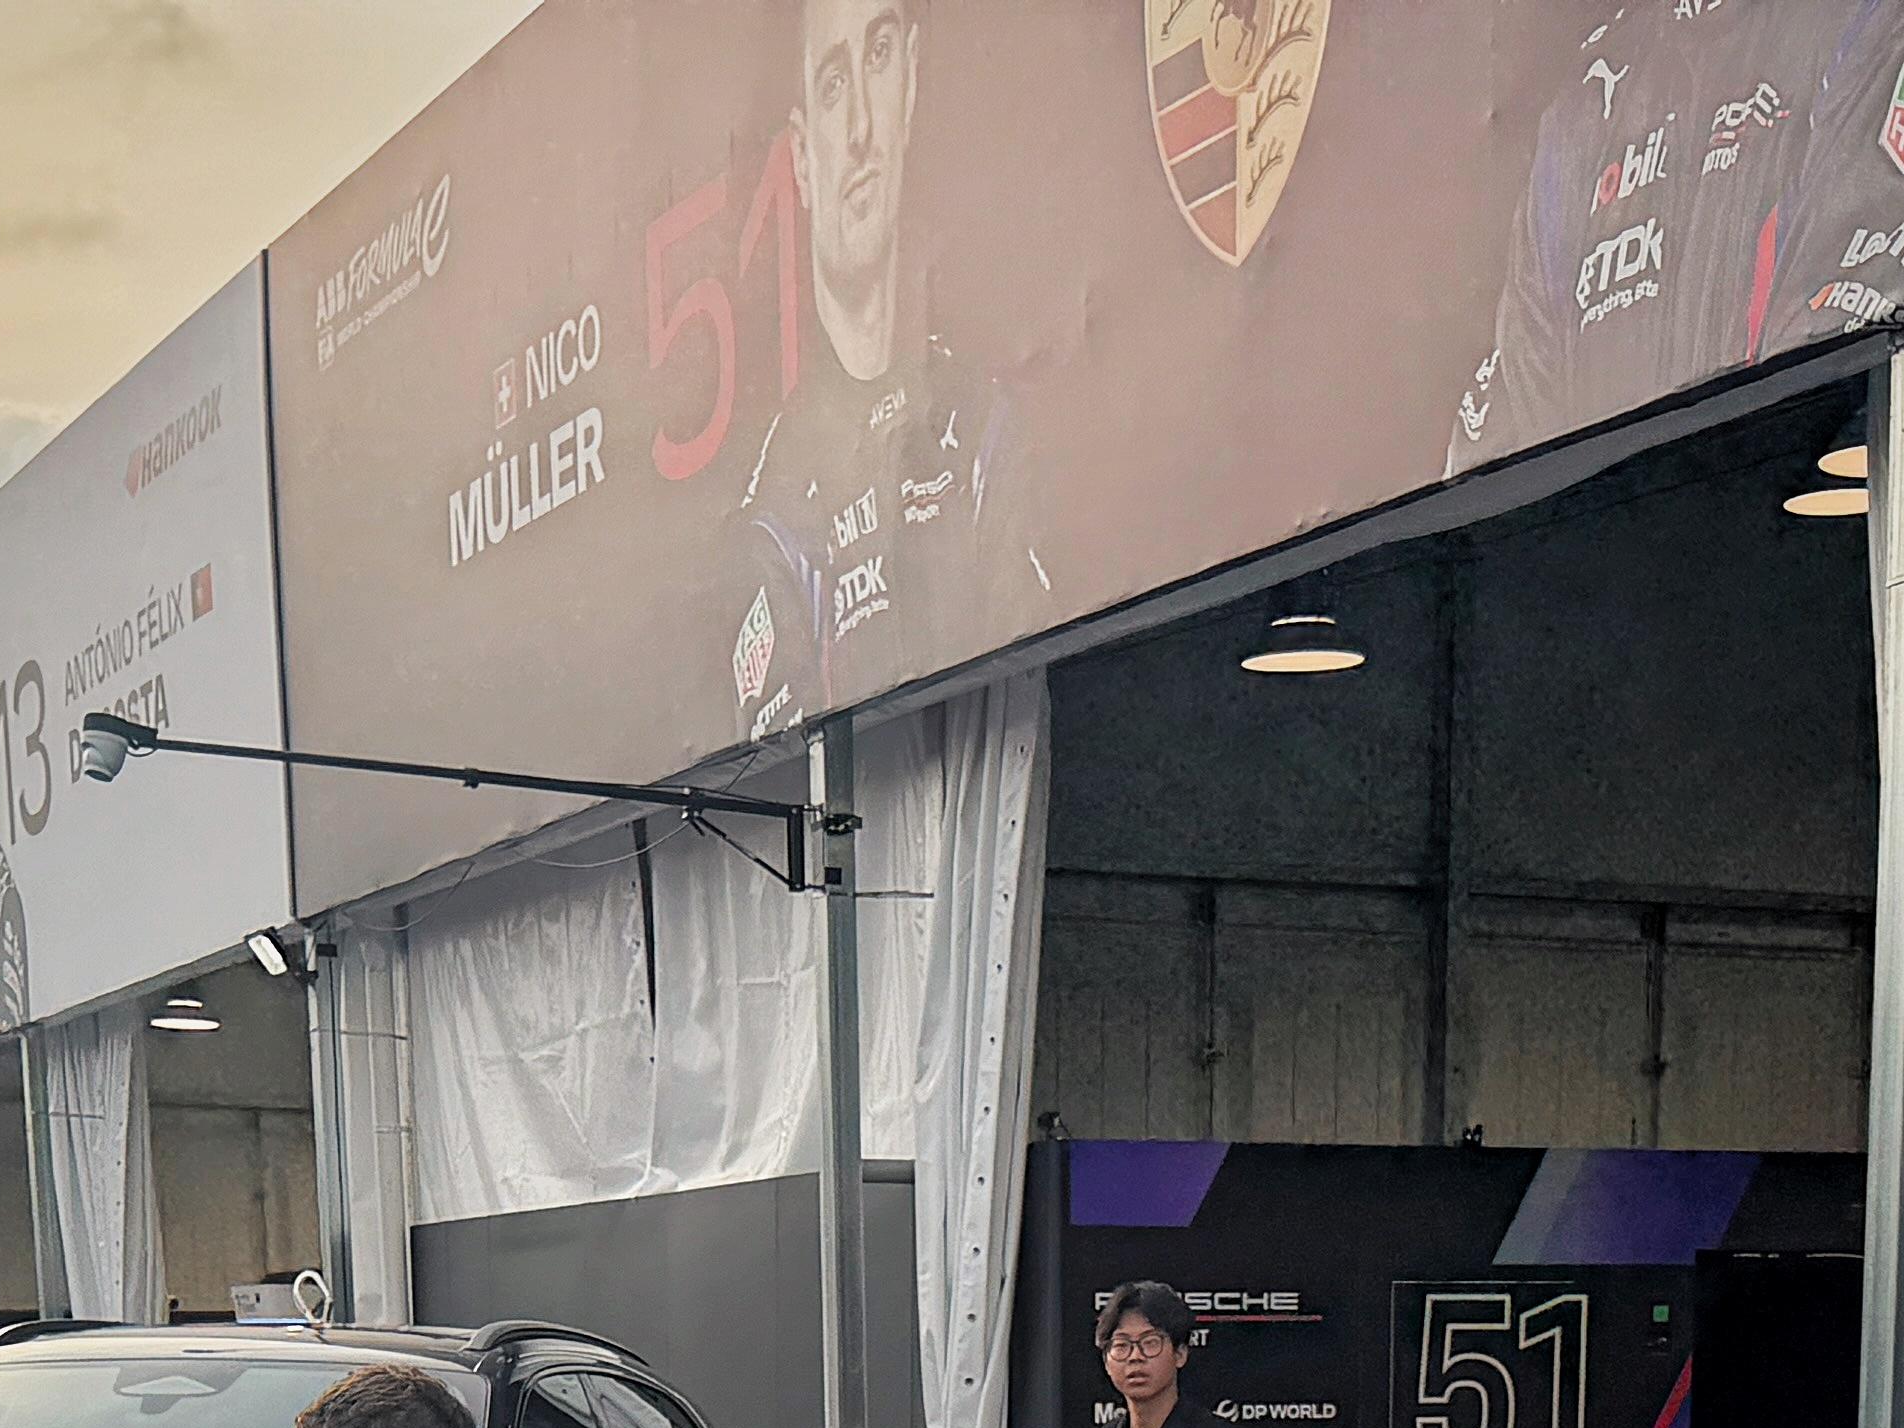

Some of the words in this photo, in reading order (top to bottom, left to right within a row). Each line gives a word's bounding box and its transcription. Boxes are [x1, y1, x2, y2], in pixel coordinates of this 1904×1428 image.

[1590, 127, 1666, 217] obil
[346, 198, 425, 312] FORMULA
[1594, 217, 1663, 292] TDK
[644, 125, 802, 483] 51
[525, 304, 602, 409] NICO
[447, 406, 607, 567] MÜLLER
[65, 622, 134, 706] ANTÓNIO
[136, 584, 186, 658] FÉLIX
[67, 727, 84, 784] D
[1095, 1292, 1301, 1311] PSCHE
[1241, 1405, 1269, 1420] DP
[1269, 1404, 1337, 1420] WORLD
